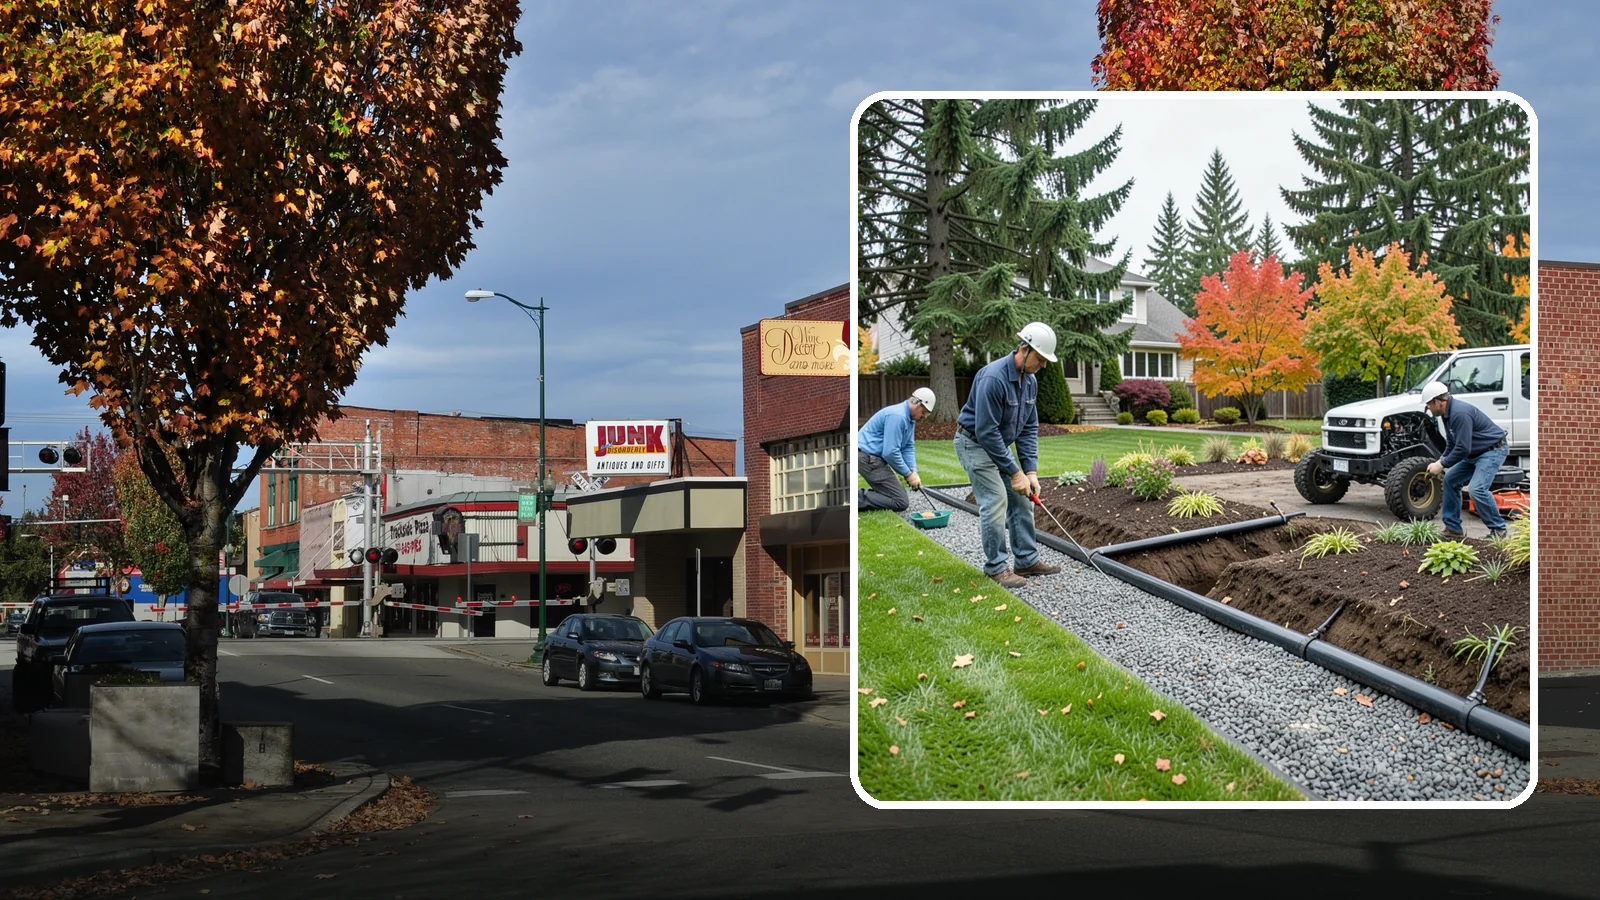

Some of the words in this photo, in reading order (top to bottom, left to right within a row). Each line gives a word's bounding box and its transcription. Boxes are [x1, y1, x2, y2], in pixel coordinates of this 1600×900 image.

[595, 425, 665, 457] JUNK
[607, 446, 645, 454] DISORDERLY
[597, 461, 628, 470] ANTIQUES
[631, 461, 644, 470] AND
[646, 460, 666, 470] GIFTS
[390, 521, 413, 540] Trackside
[414, 519, 429, 535] Pizza
